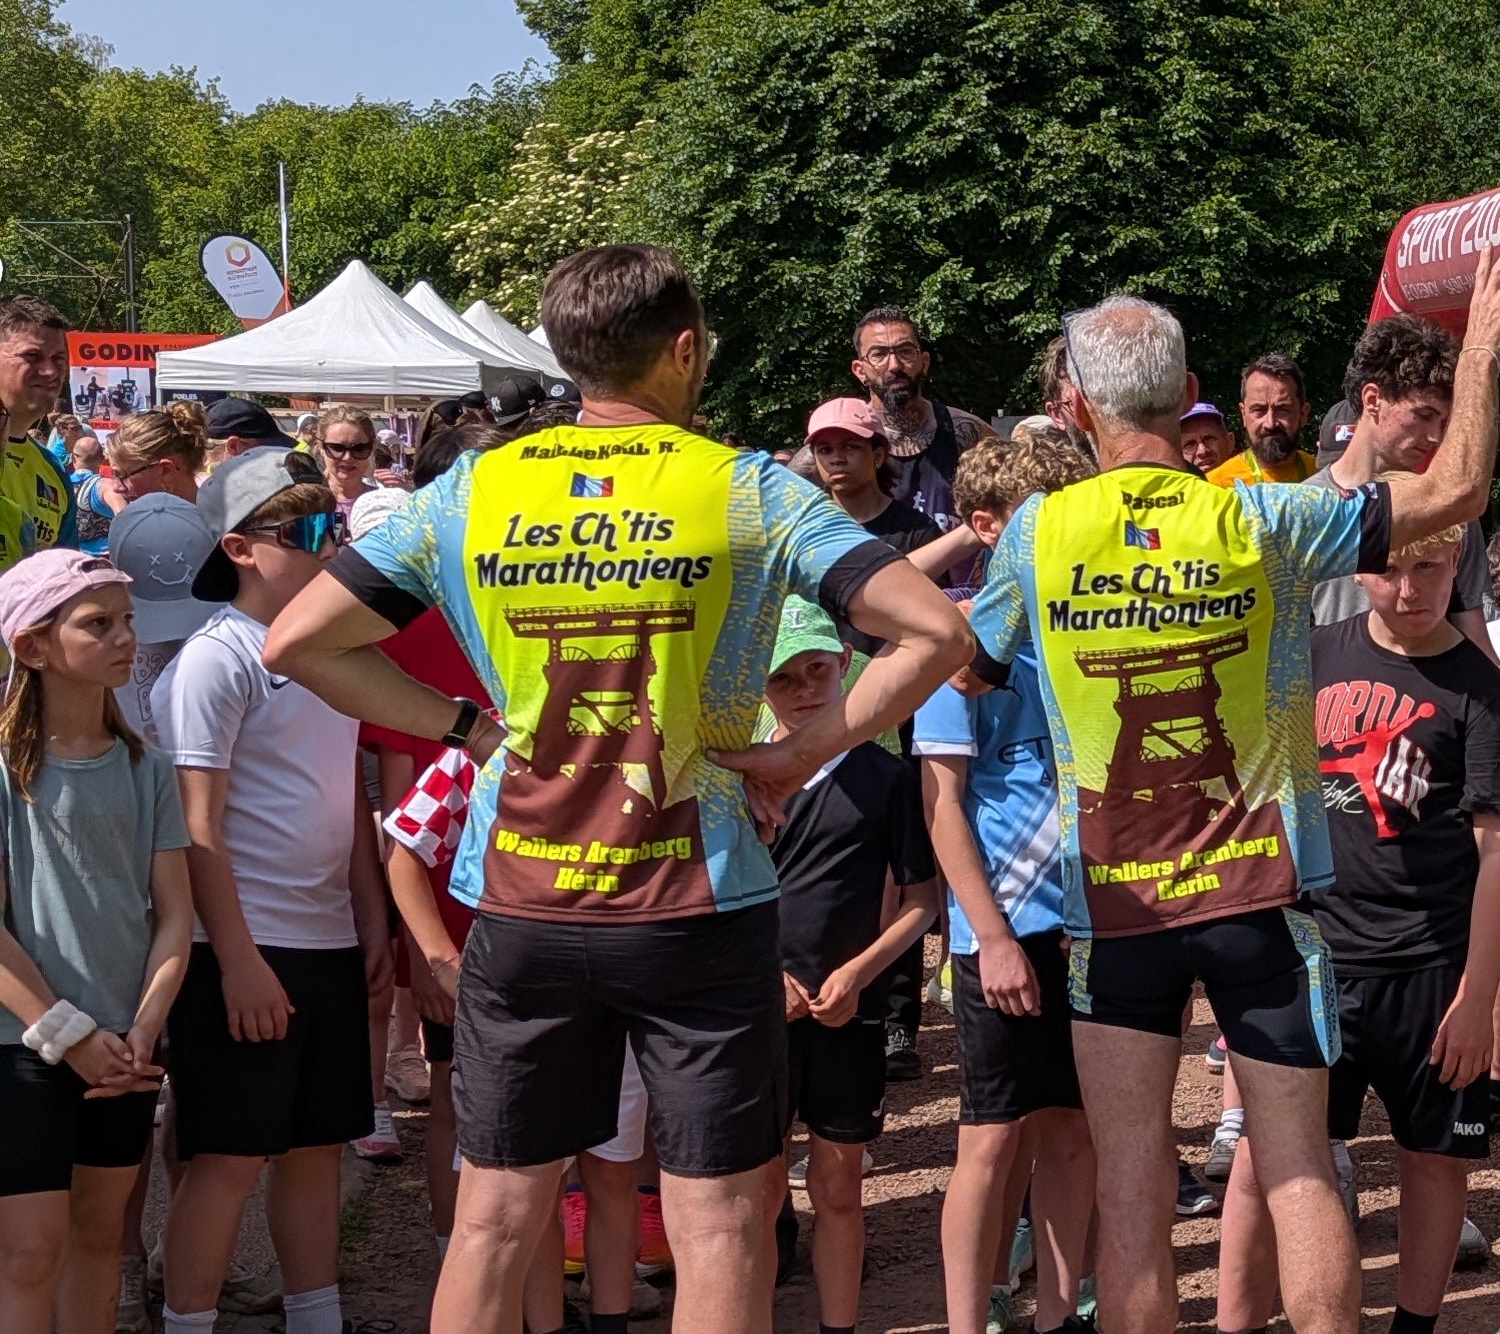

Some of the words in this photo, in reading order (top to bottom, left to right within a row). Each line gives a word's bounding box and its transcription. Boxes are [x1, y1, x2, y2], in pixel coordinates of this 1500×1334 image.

[1397, 202, 1474, 268] SPORT
[79, 343, 160, 362] GODIN
[1121, 490, 1185, 510] Pascal
[503, 514, 563, 548] Les
[571, 510, 675, 553] Ch'tis
[473, 549, 713, 592] Marathoniens
[1071, 563, 1124, 596] Les
[1131, 559, 1220, 599] Ch'tis
[1046, 586, 1256, 633] Marathoniens
[495, 829, 582, 862] Wallers
[584, 836, 692, 865] Arenberg
[1088, 860, 1174, 886] Wallers
[1180, 835, 1280, 871] Arenberg
[553, 867, 619, 893] Hérin
[1156, 872, 1221, 902] Hérin
